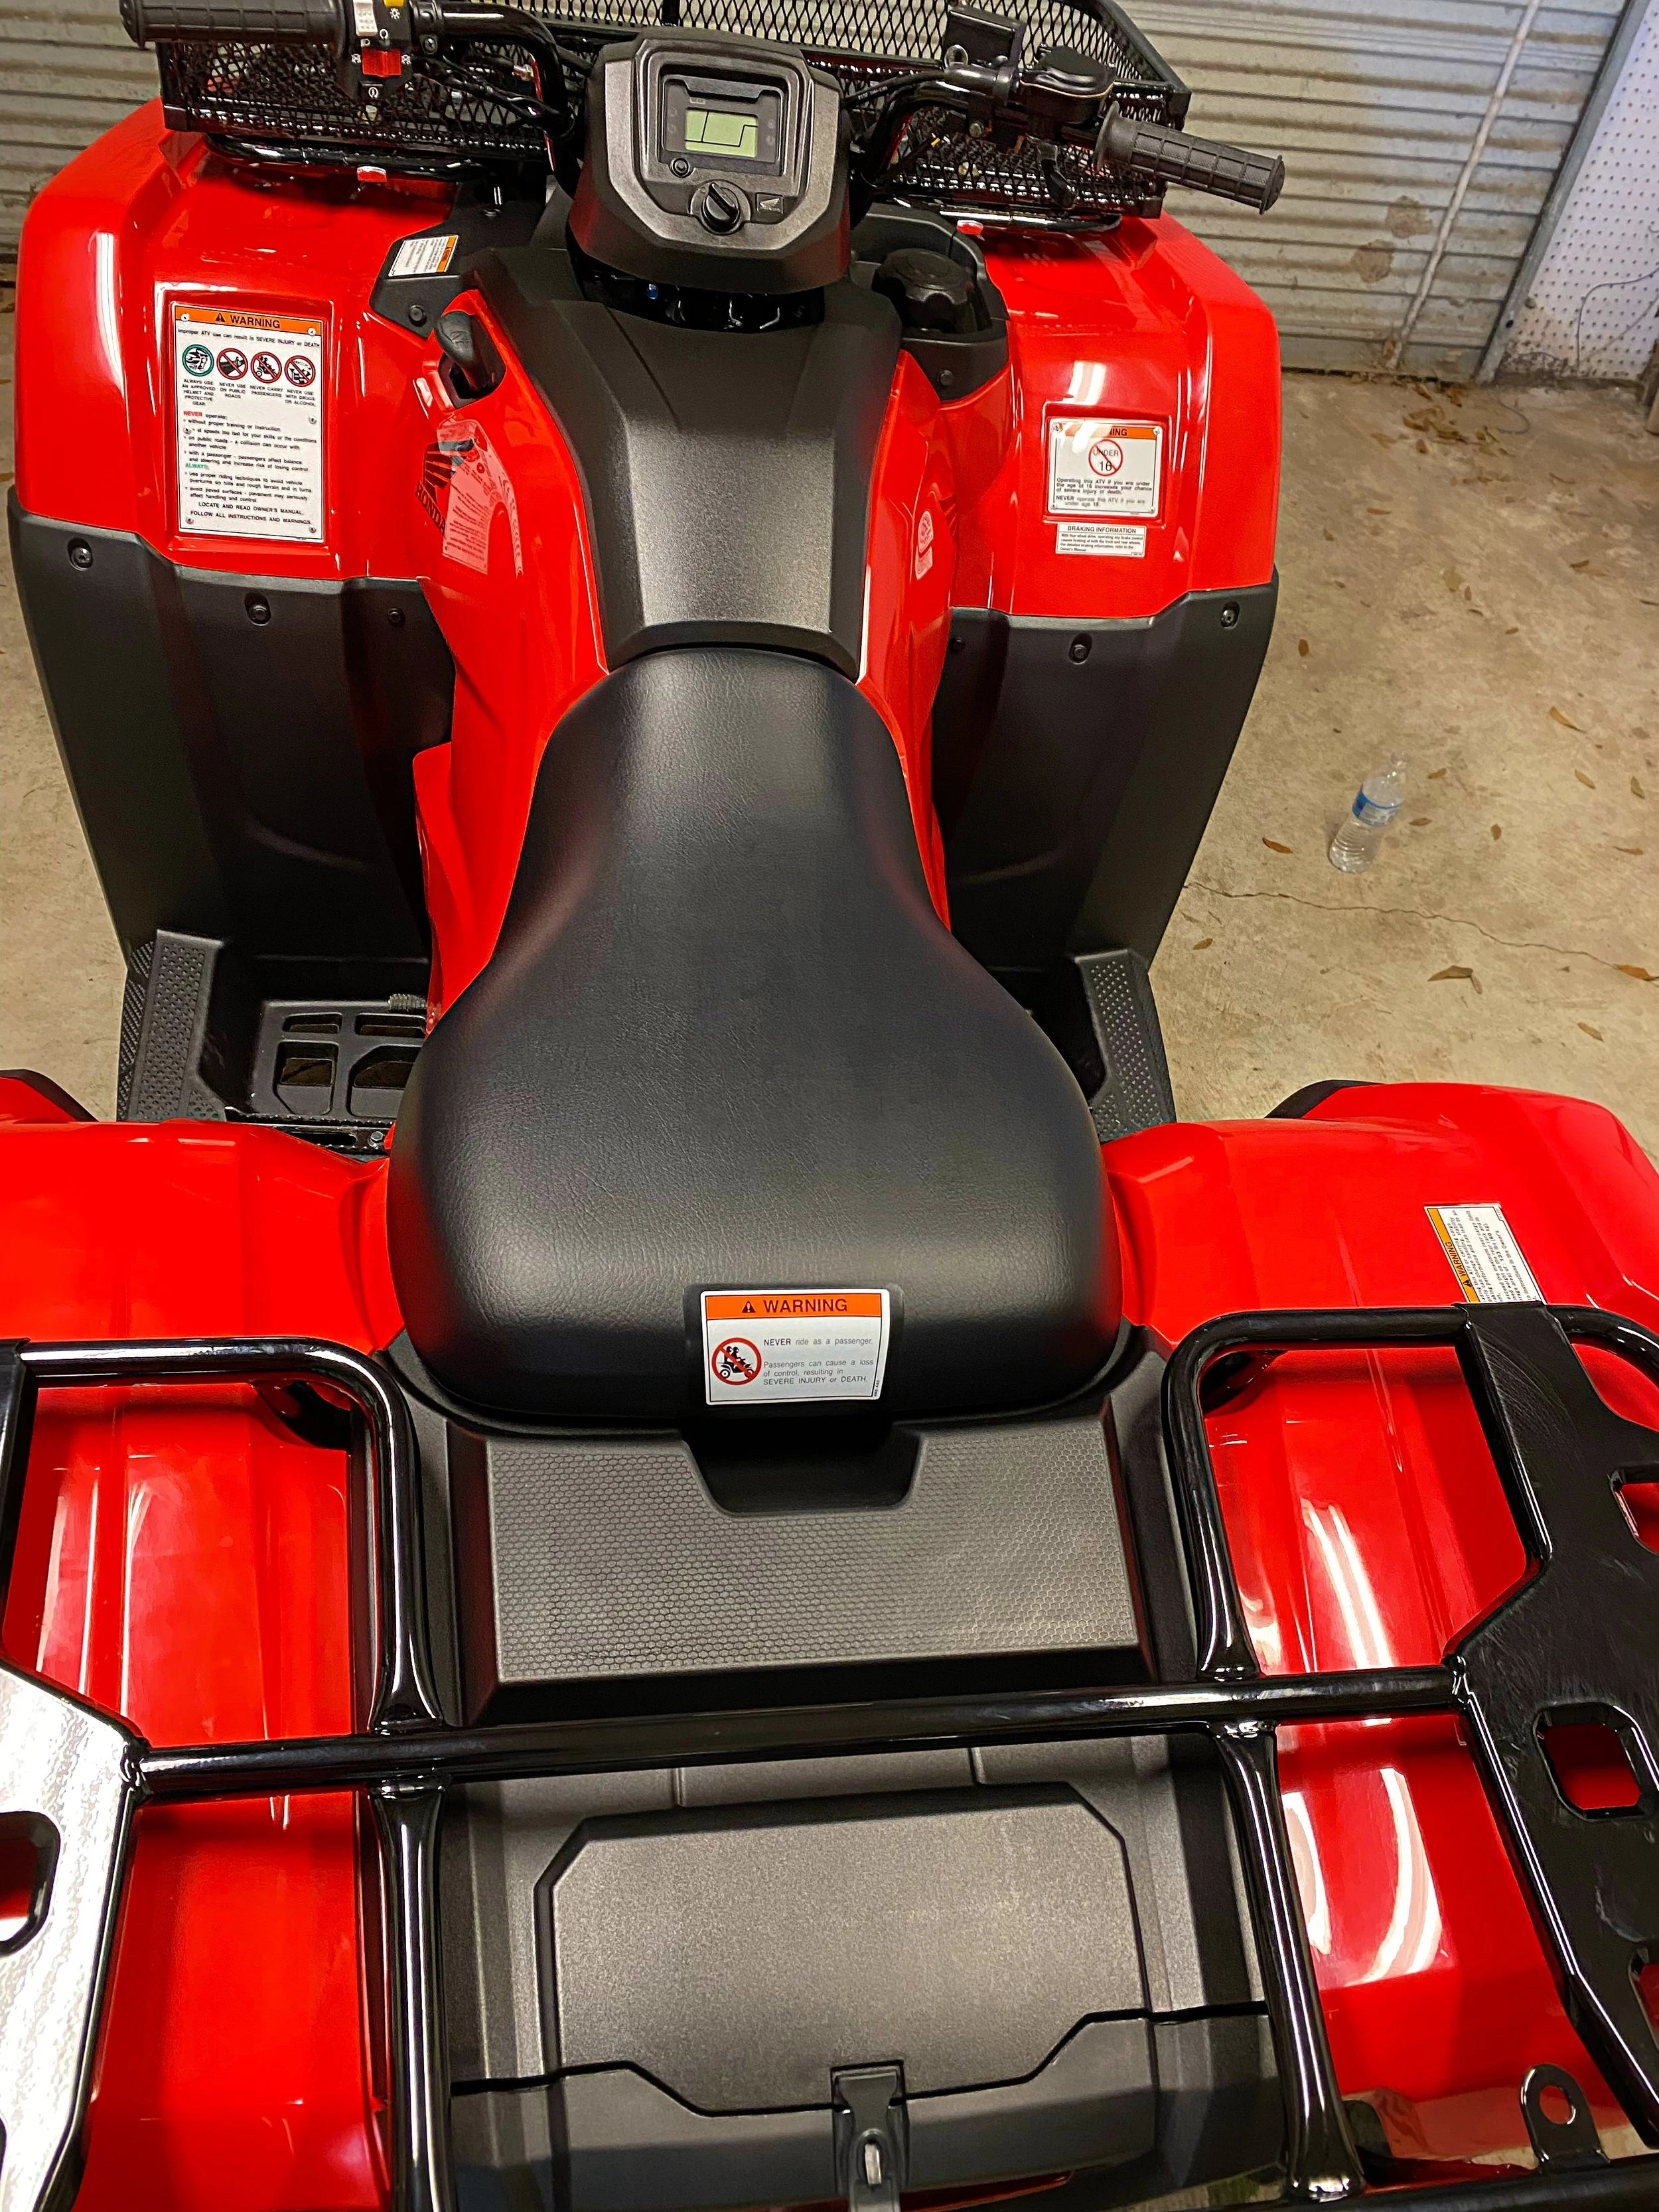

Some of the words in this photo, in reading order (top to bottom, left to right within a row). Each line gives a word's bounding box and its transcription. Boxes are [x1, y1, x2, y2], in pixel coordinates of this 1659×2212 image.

[230, 315, 279, 328] WARNING
[1099, 461, 1112, 471] 16
[415, 480, 446, 536] HONDA
[1444, 1242, 1467, 1276] WARNING
[763, 1298, 847, 1313] WARNING
